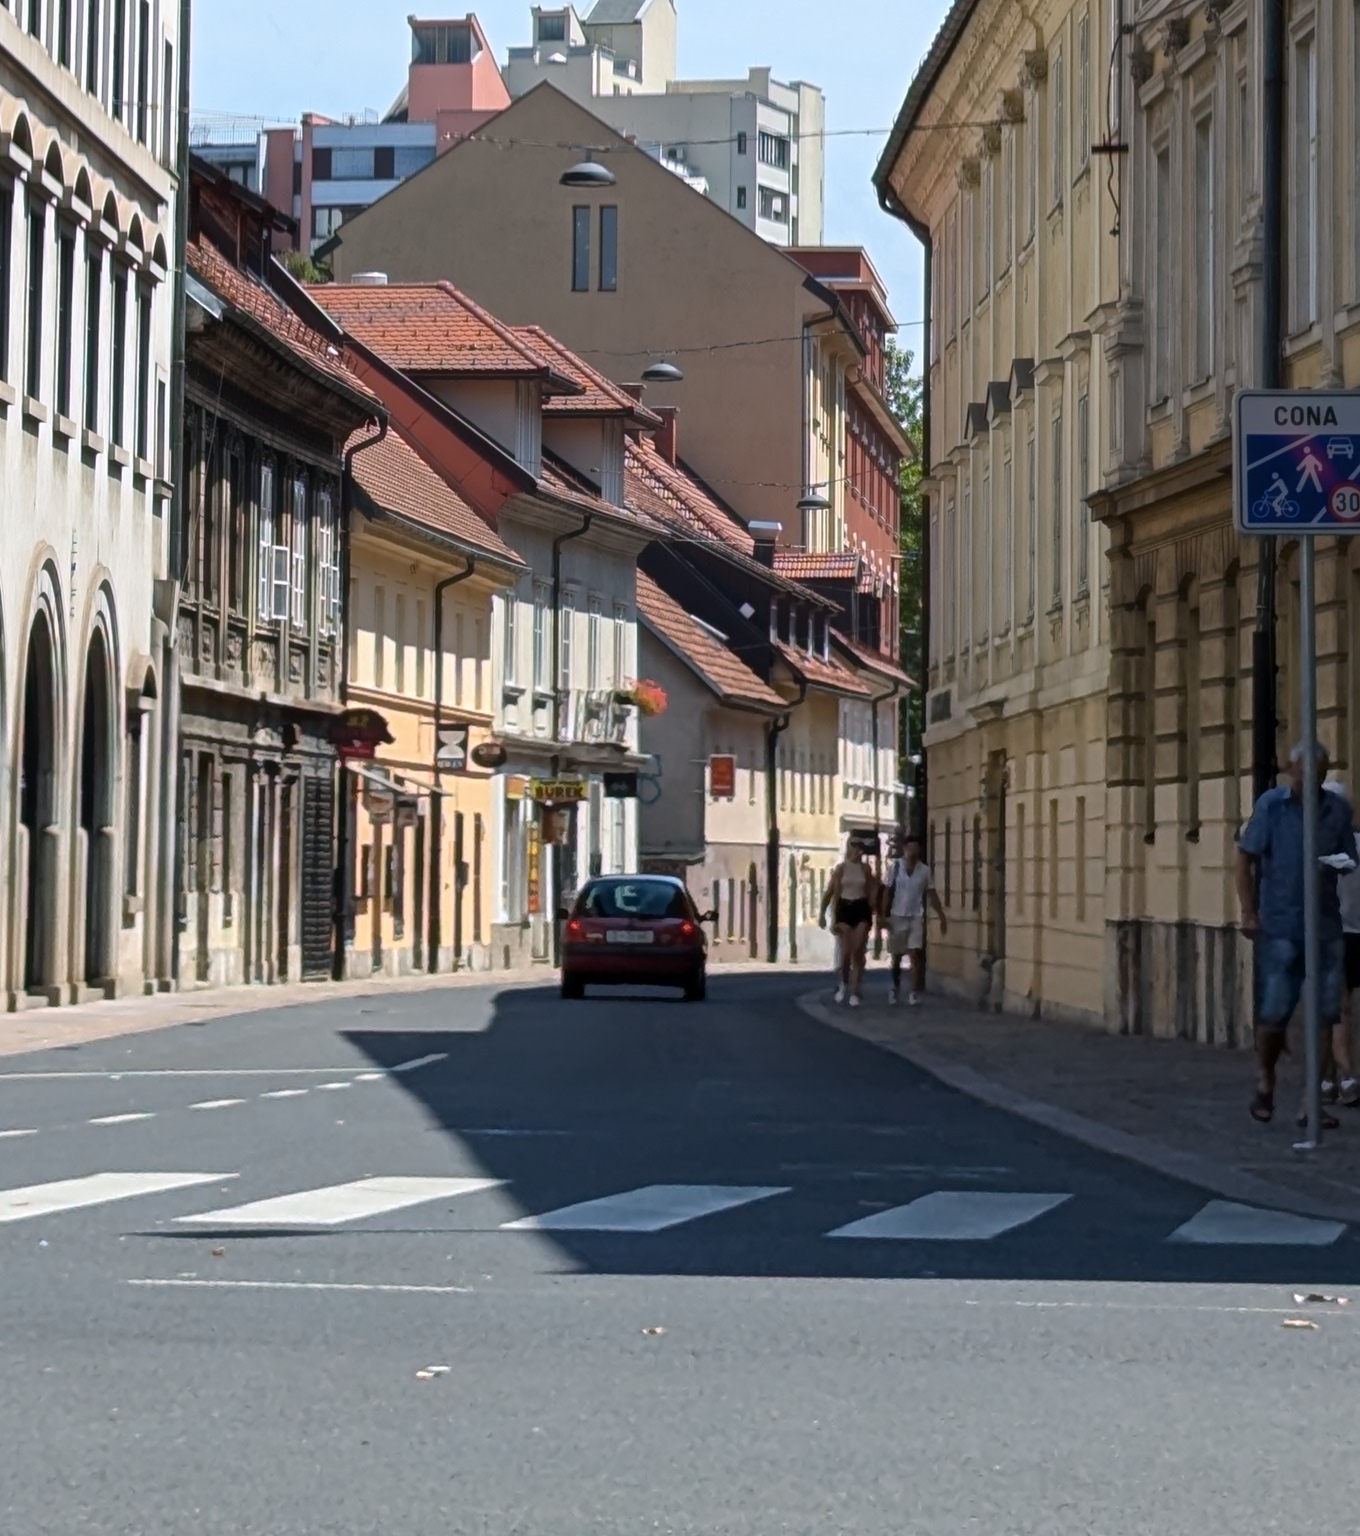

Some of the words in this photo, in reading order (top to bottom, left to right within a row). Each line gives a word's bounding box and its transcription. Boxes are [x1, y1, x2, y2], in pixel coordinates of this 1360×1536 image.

[1274, 406, 1338, 426] CONA
[1336, 492, 1360, 512] 30
[535, 785, 583, 798] BUREK
